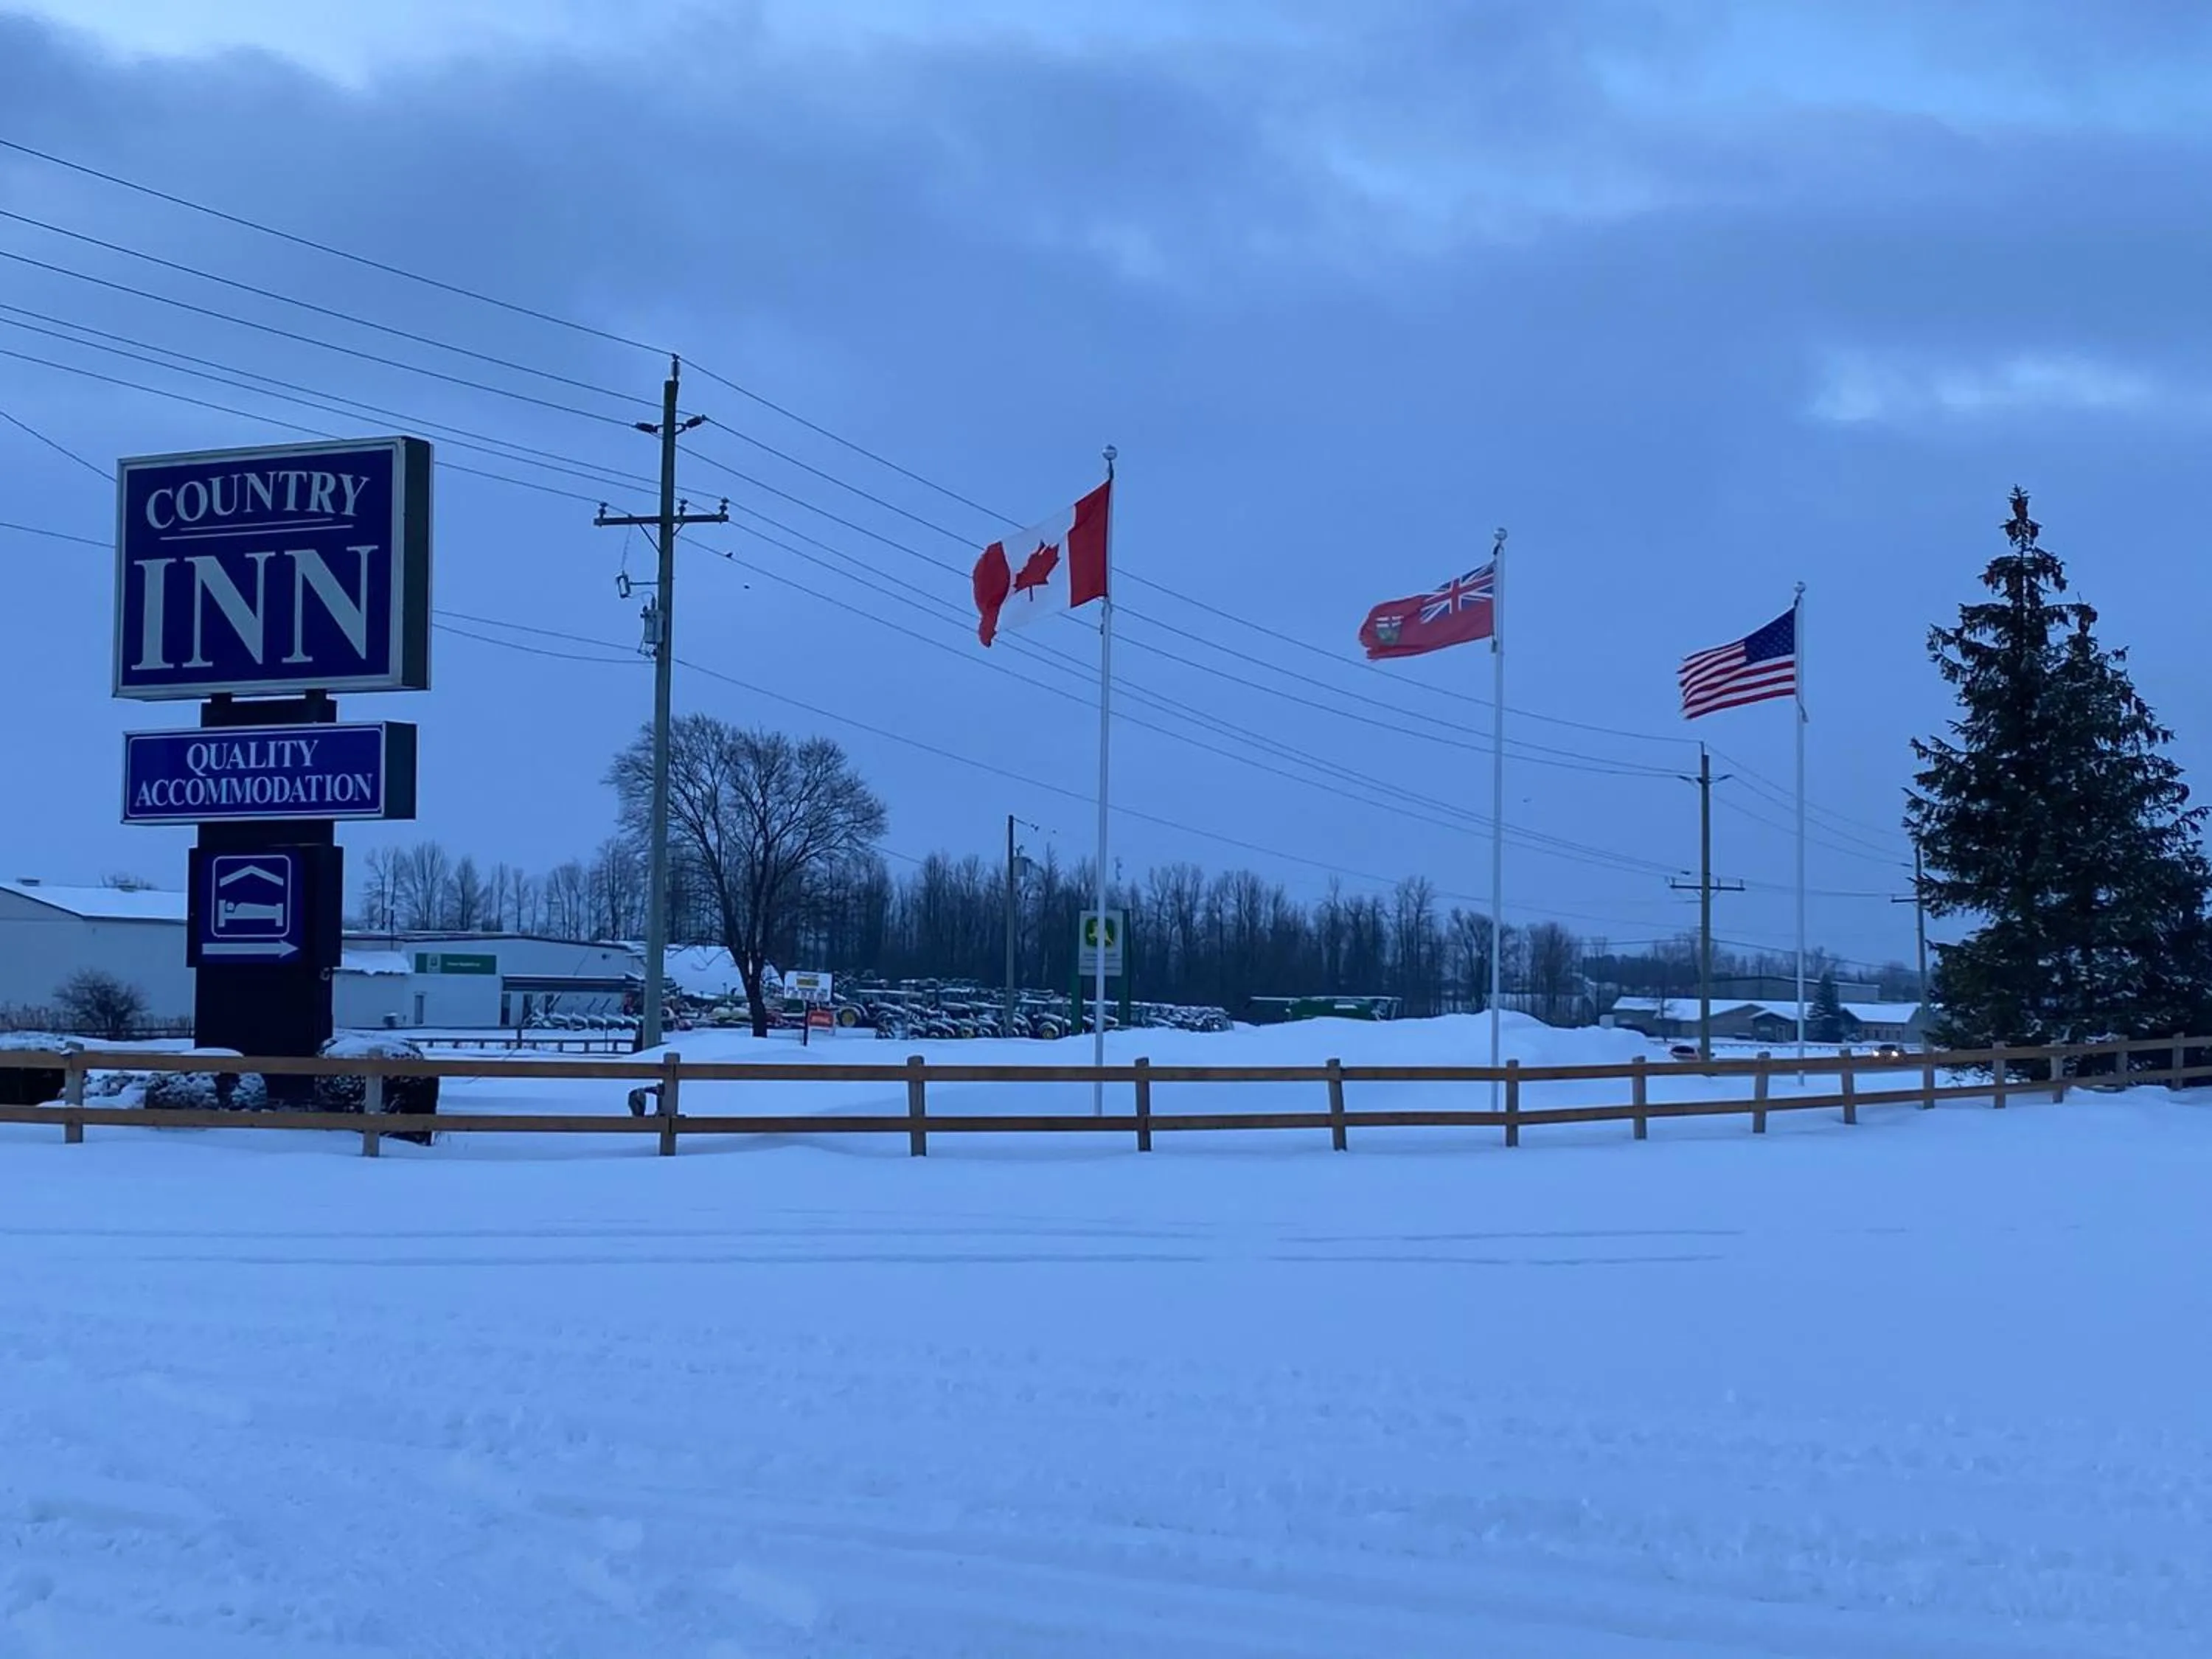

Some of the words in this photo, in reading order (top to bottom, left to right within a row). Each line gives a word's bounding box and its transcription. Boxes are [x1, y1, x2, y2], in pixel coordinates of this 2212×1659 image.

[146, 470, 370, 529] COUNTRY
[131, 545, 379, 670] INN
[187, 740, 319, 776] QUALITY
[134, 773, 373, 807] ACCOMMODATION
